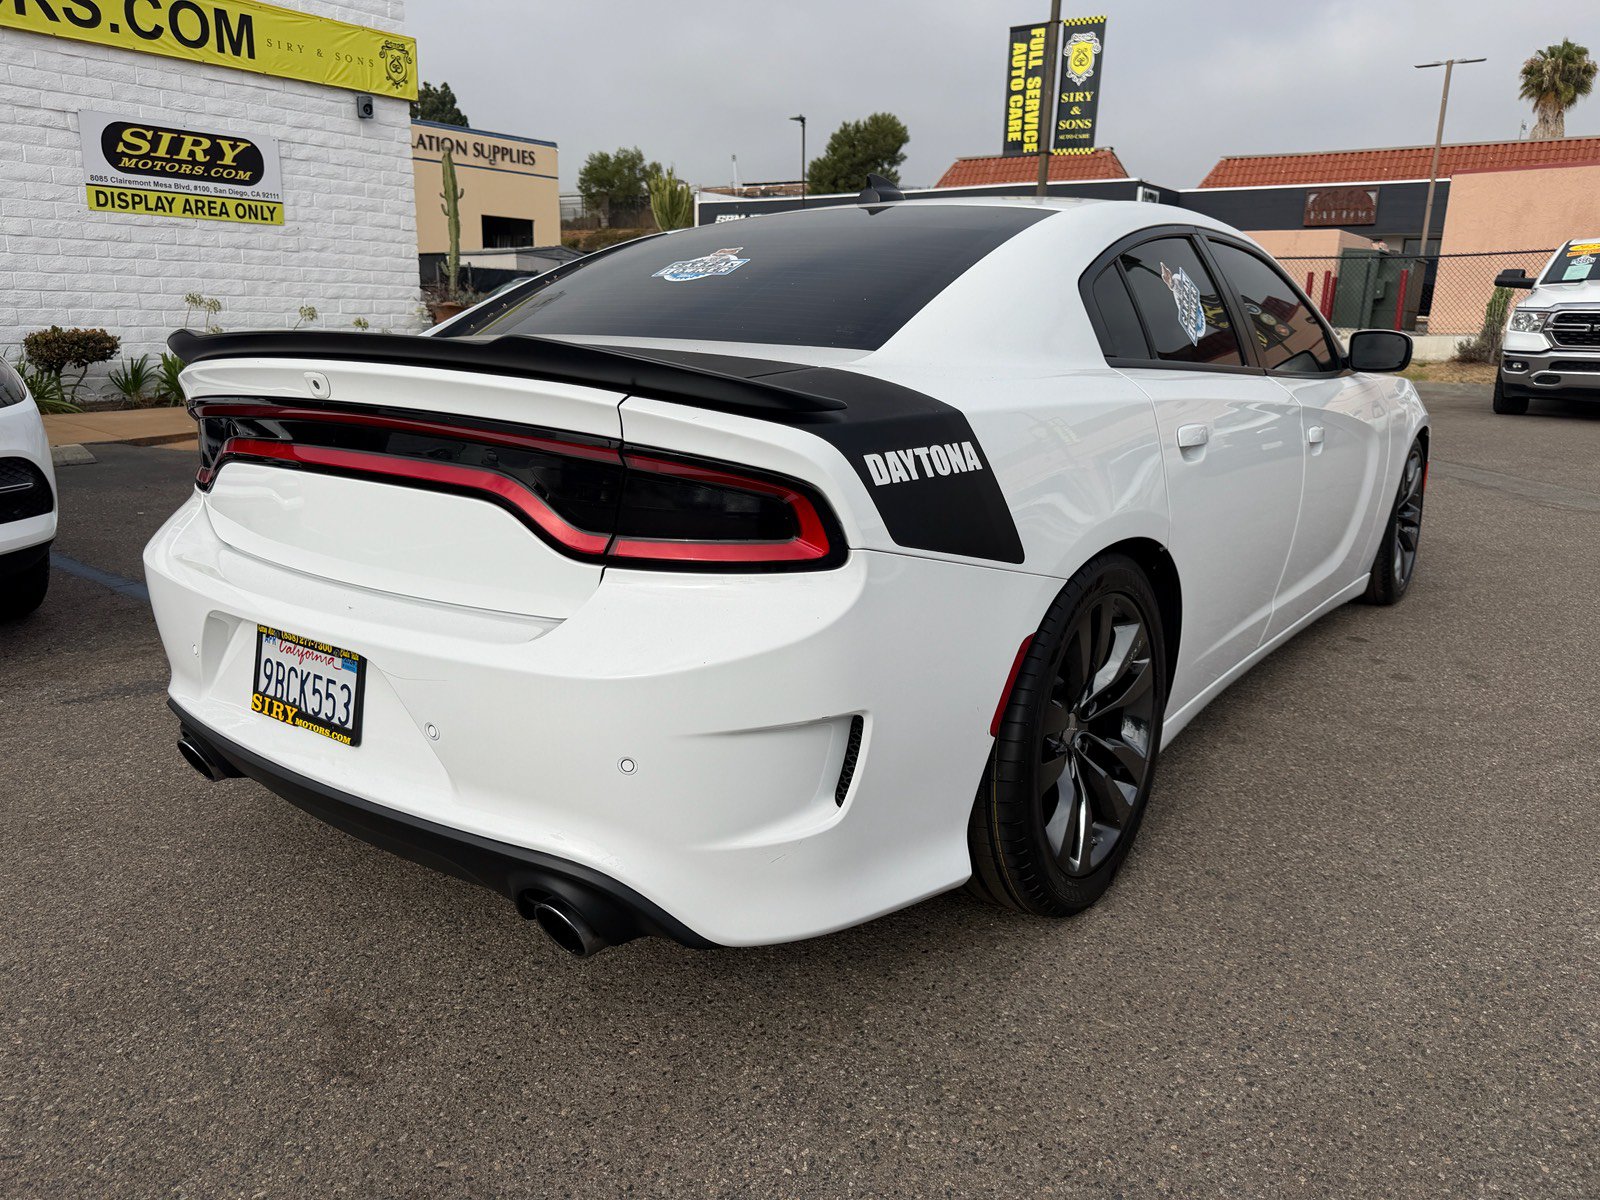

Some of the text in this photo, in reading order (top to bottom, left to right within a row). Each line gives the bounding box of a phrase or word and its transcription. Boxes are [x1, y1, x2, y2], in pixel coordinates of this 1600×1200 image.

[266, 38, 374, 68] SIRY & SONS
[1007, 43, 1028, 142] AUTO CARE
[1023, 27, 1046, 153] FULL SERVICE
[1061, 91, 1094, 103] SIRY
[1058, 119, 1092, 130] SONS
[1070, 106, 1082, 115] &
[116, 127, 251, 166] SIRY
[473, 142, 536, 166] SUPPLIES
[90, 174, 108, 182] 8085
[110, 176, 151, 188] Clairemont
[153, 180, 172, 188] Mesa
[118, 157, 253, 181] MOTORS.COM
[95, 190, 277, 222] DISPLAY AREA ONLY
[863, 441, 983, 486] DAYTONA
[279, 640, 342, 670] California
[263, 658, 352, 727] 9BCK553
